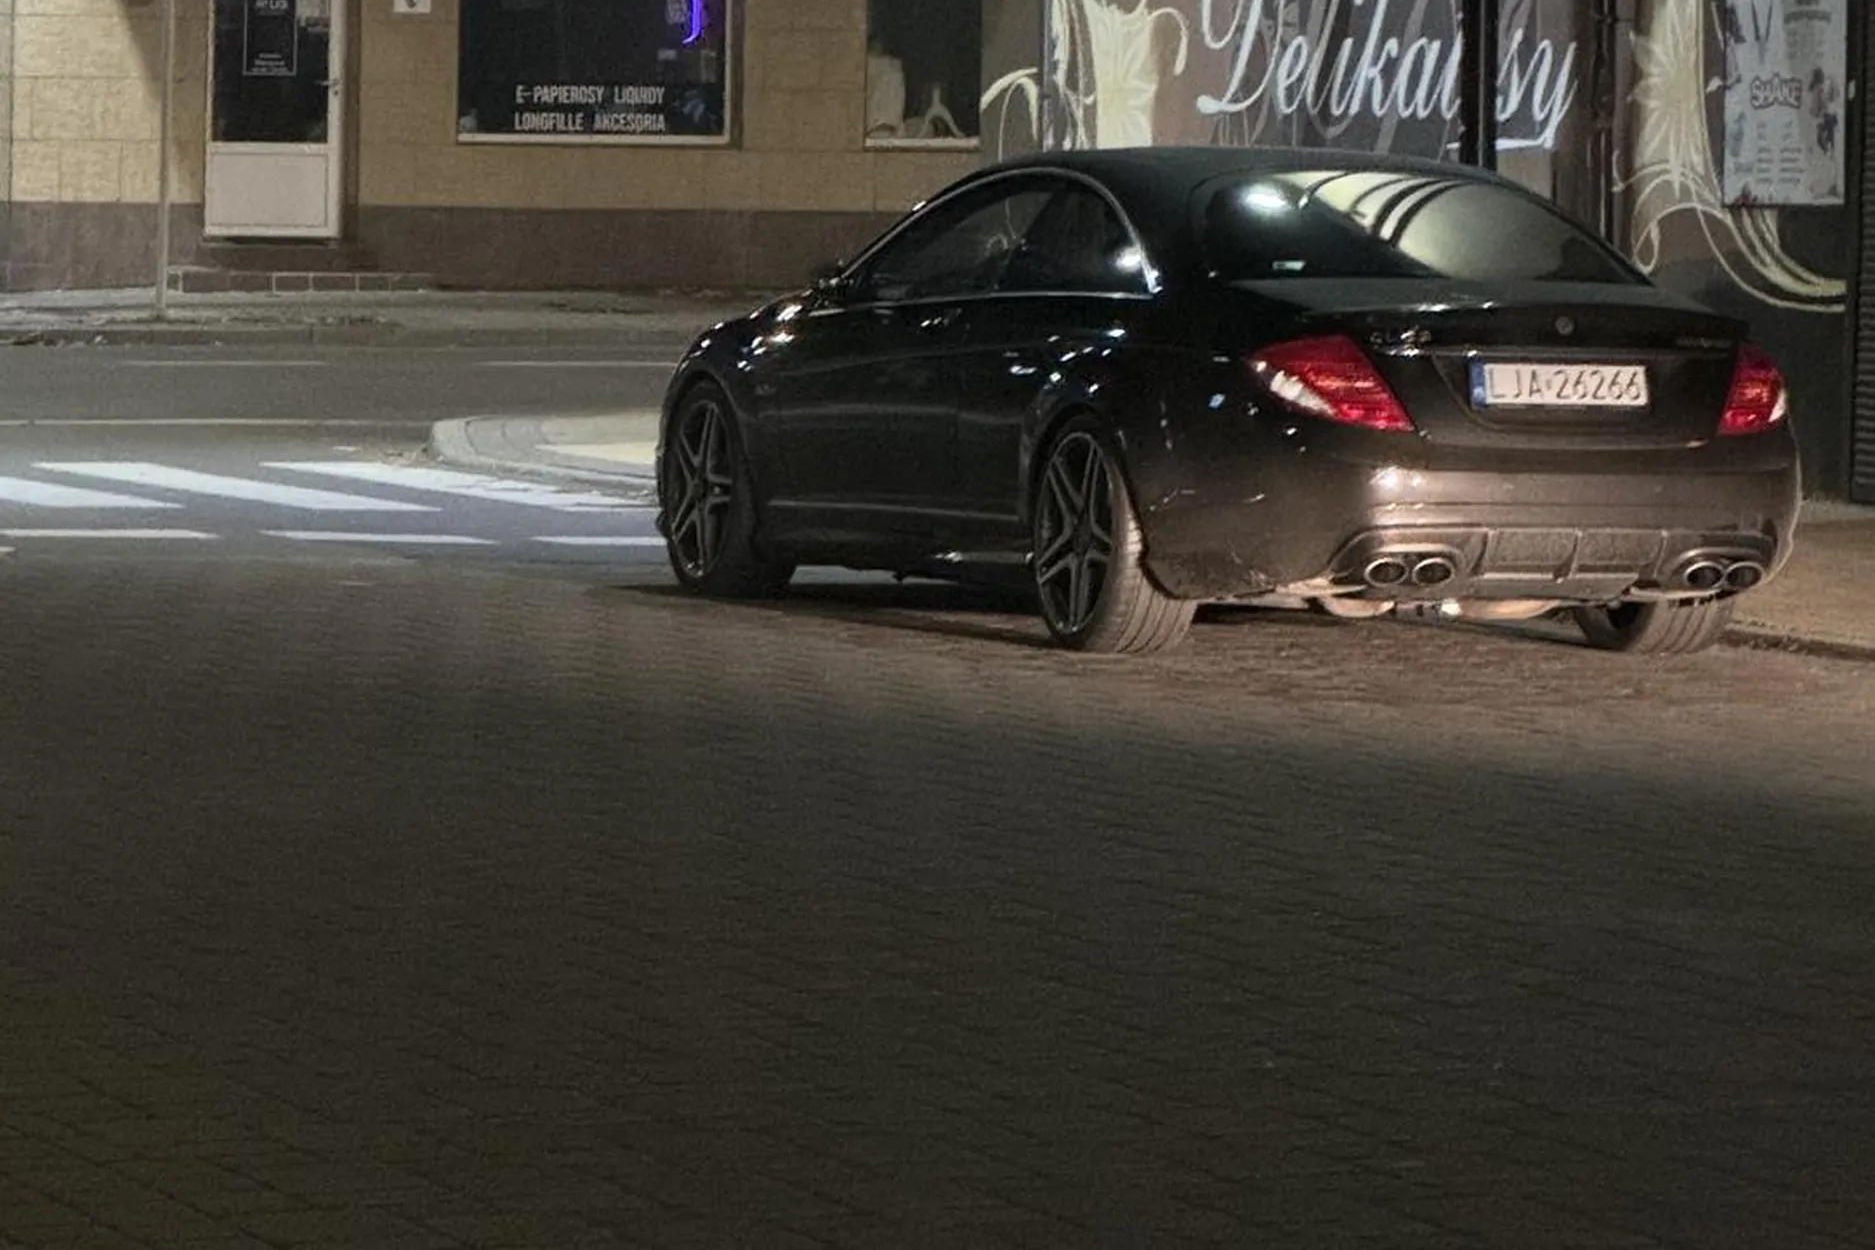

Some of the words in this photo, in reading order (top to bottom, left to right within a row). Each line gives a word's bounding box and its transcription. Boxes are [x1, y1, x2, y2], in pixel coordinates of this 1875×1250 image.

[515, 85, 605, 105] E-PAPIEROSY
[593, 112, 666, 133] AKCESORIA
[1488, 367, 1543, 399] LJA
[1553, 368, 1642, 401] 26266
